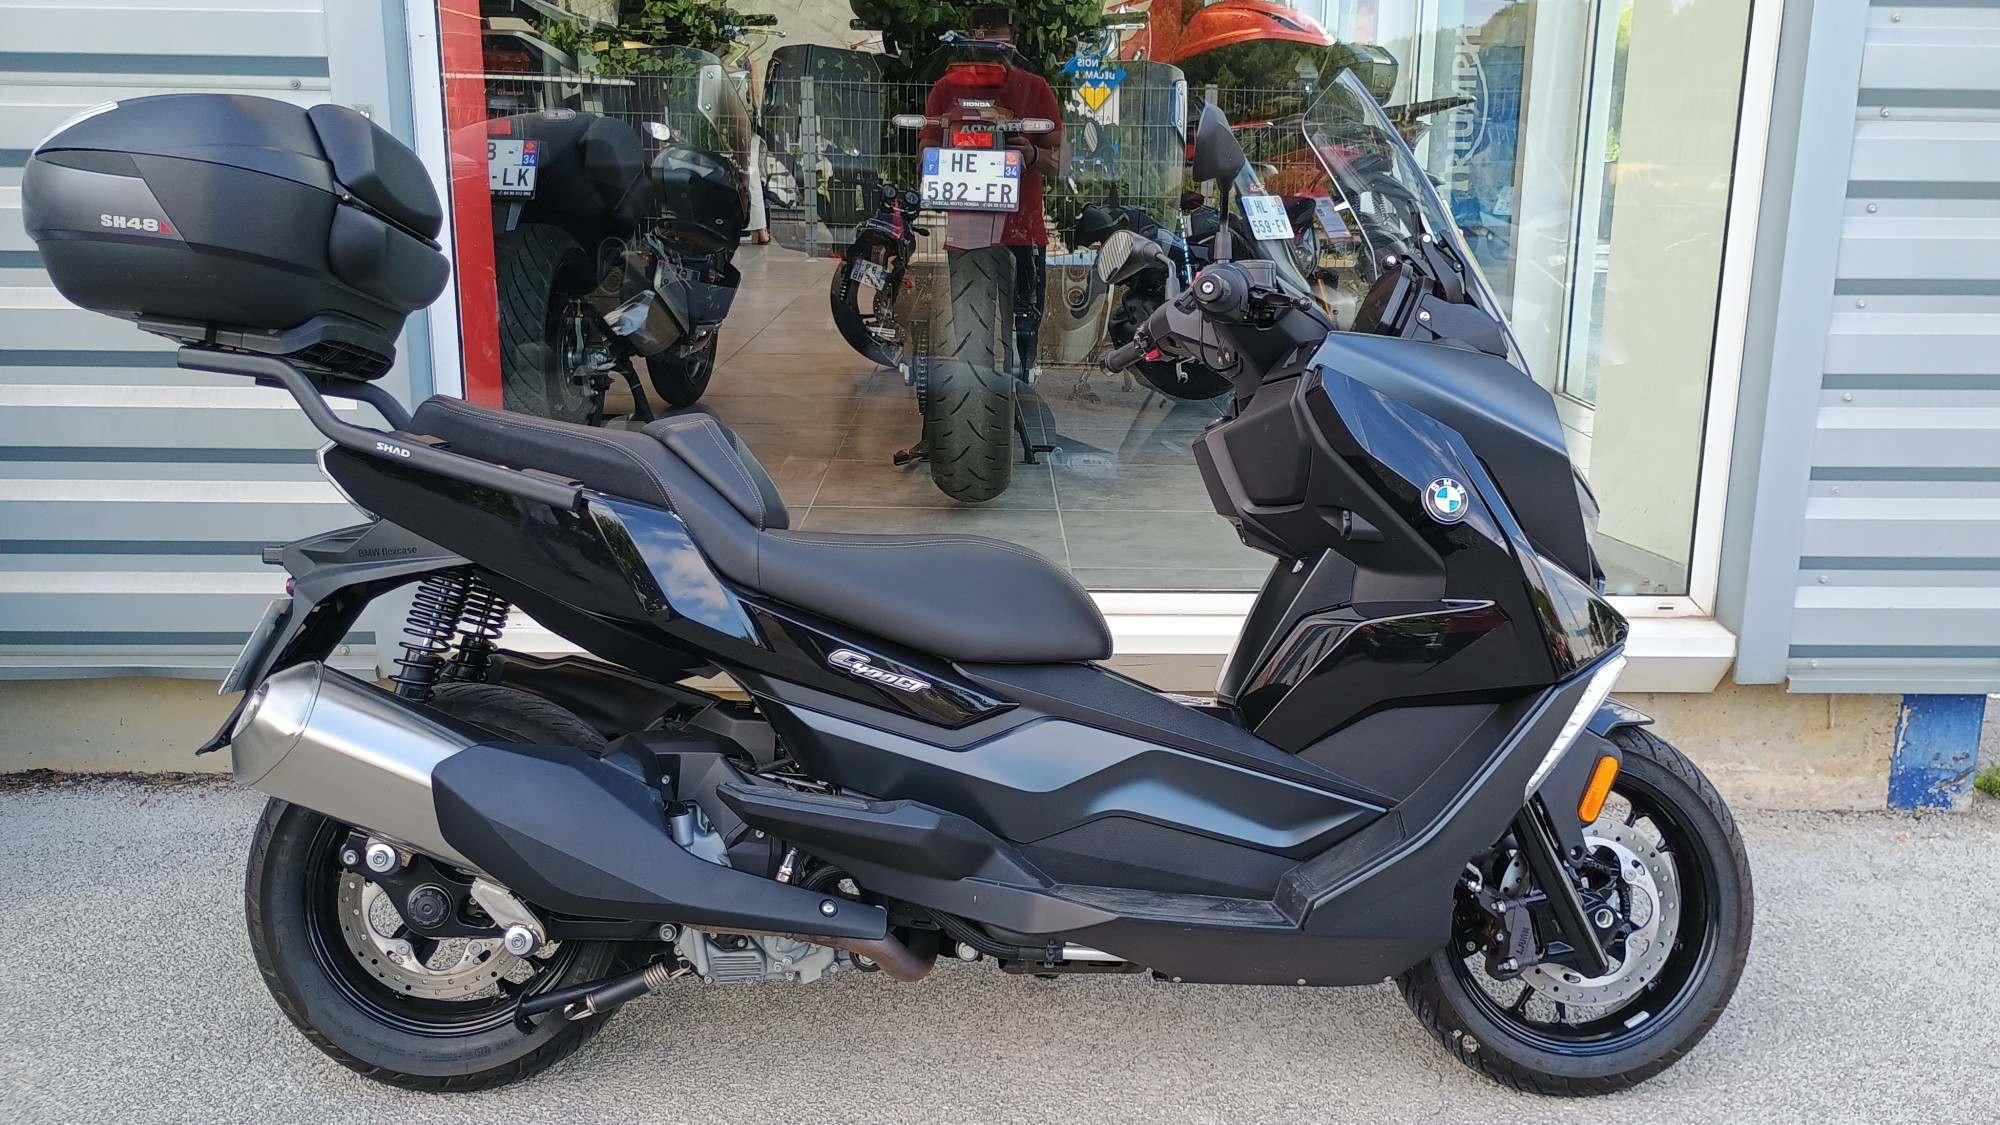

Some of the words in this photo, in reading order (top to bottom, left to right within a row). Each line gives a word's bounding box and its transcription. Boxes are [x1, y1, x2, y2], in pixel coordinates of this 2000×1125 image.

[522, 154, 535, 165] 34
[928, 164, 935, 172] F
[1005, 166, 1017, 177] 34
[100, 214, 159, 232] SH48
[376, 441, 411, 458] SHAD
[358, 547, 380, 558] BMW
[382, 546, 418, 556] flexcase
